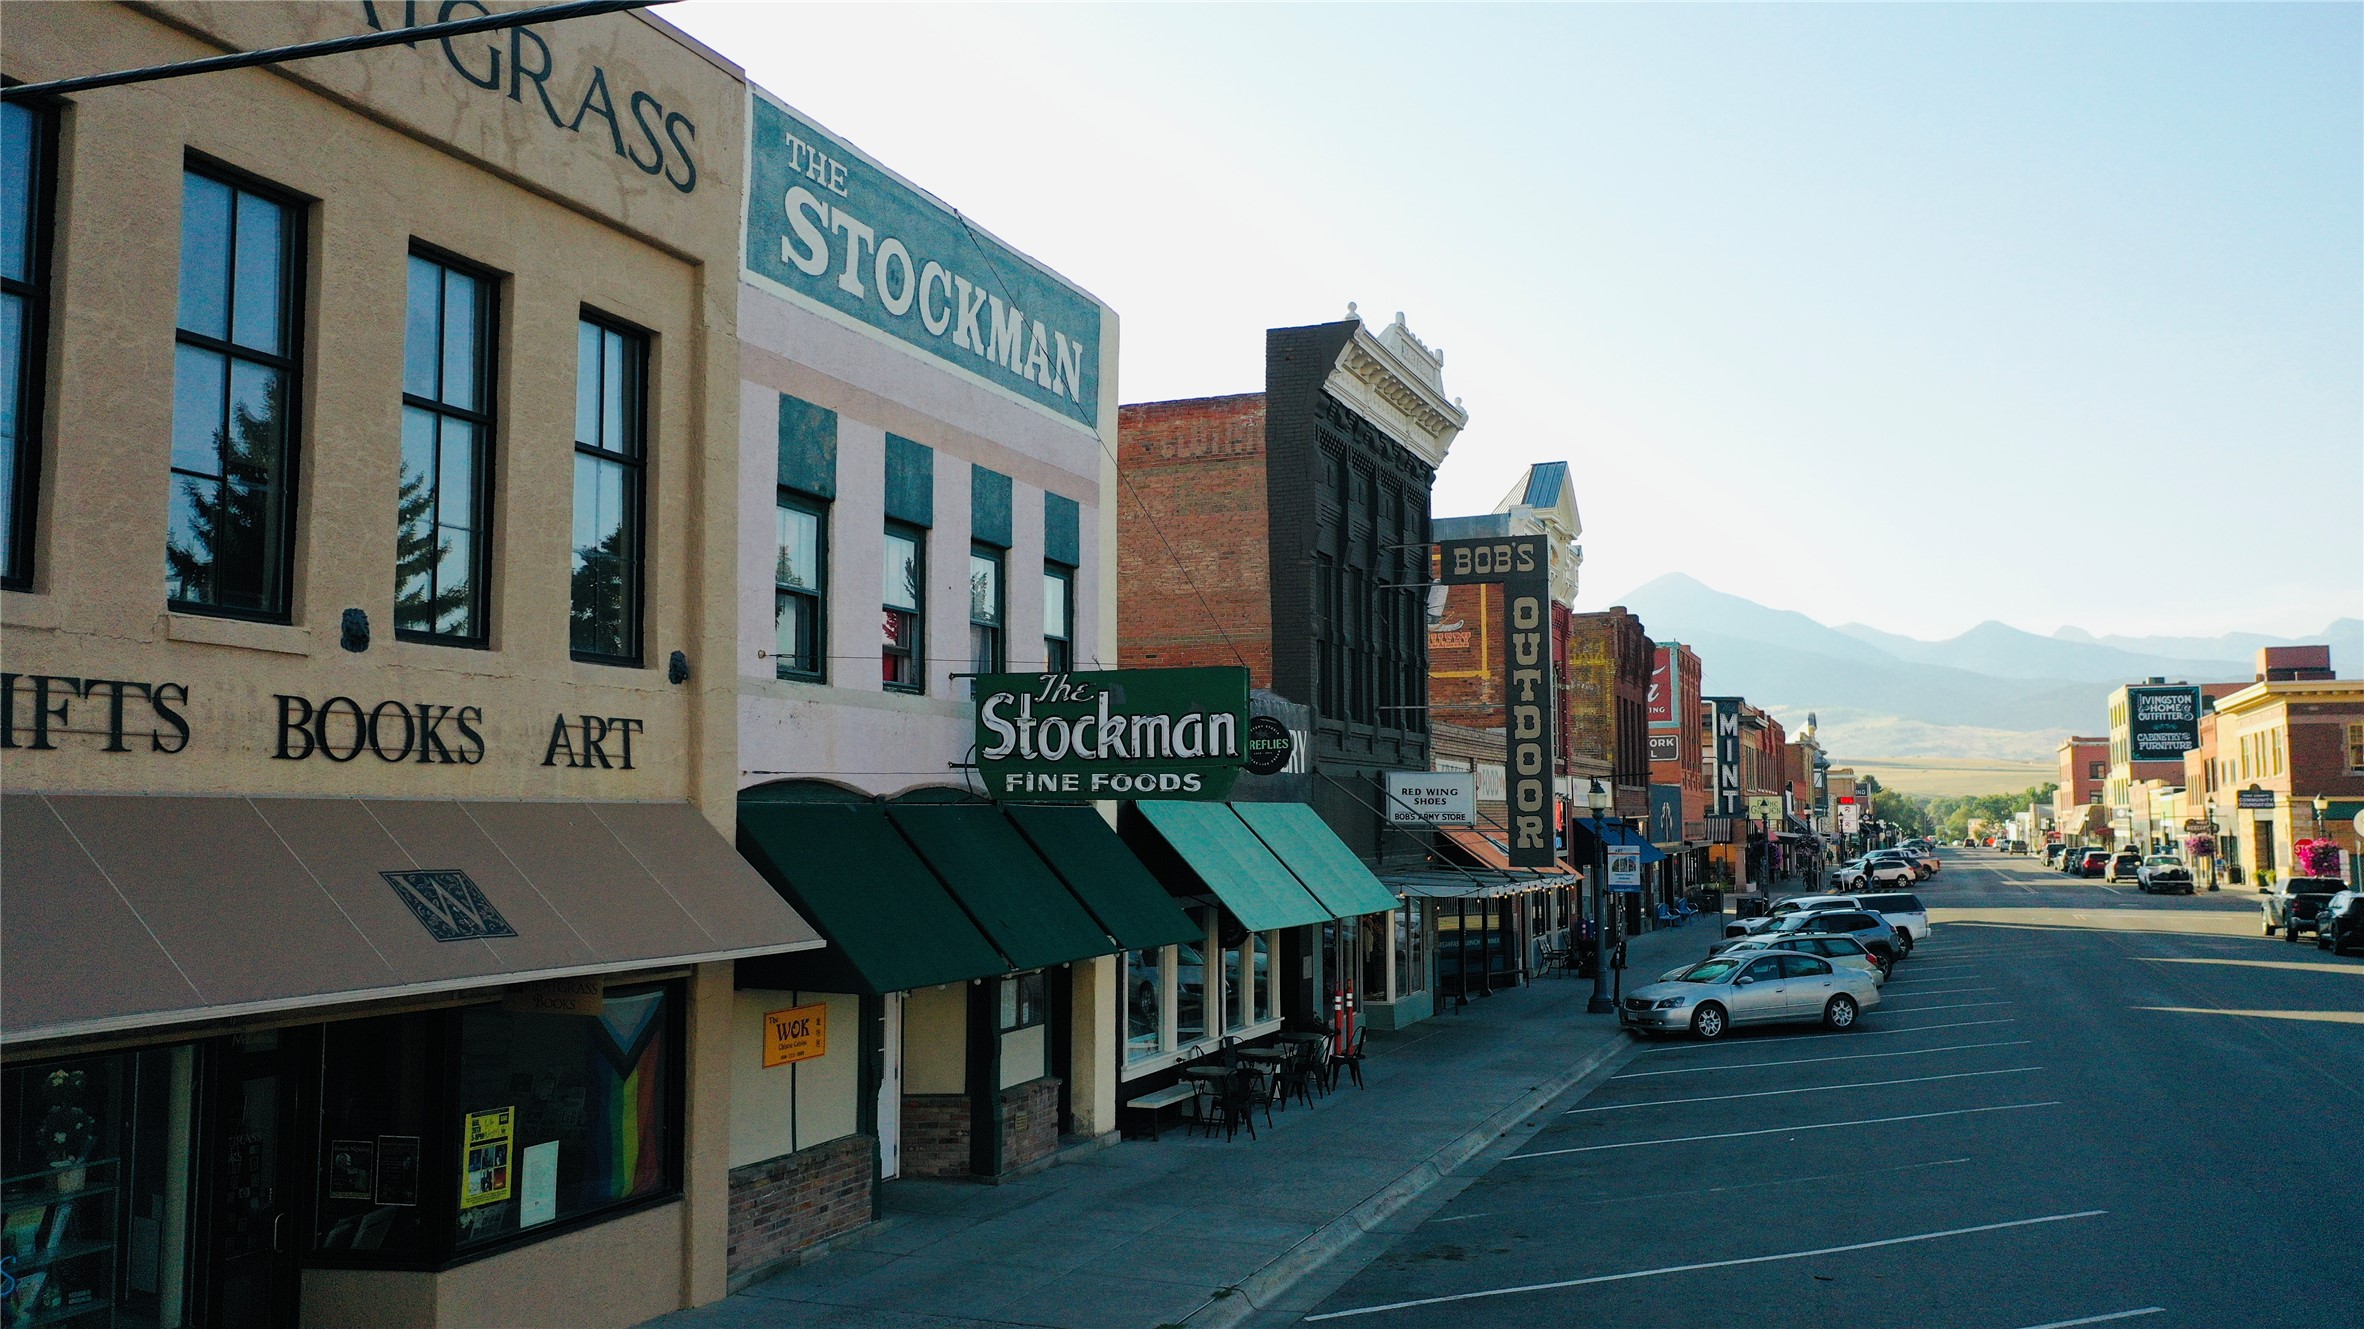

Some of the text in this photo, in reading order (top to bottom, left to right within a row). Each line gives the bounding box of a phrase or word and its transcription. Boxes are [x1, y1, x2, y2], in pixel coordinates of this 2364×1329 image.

[786, 133, 848, 198] THE
[781, 186, 1082, 404] STOCKMAN
[1454, 542, 1535, 575] BOB'S
[1428, 632, 1472, 648] LLERY
[1034, 673, 1096, 703] The
[271, 694, 485, 765] BOOKS
[540, 713, 643, 769] ART
[981, 691, 1240, 761] Stockman
[1512, 597, 1545, 849] OUTDOOR
[1249, 738, 1289, 750] REFLIES
[2137, 732, 2181, 742] CABINETRY
[2139, 741, 2193, 750] FURNITURE
[1280, 729, 1307, 774] RY
[1720, 713, 1739, 814] MINT
[1006, 772, 1202, 792] FINE FOODS
[1402, 788, 1458, 796] RED WING
[1414, 797, 1447, 805] SHOES
[1395, 812, 1415, 820] BOB'S
[1442, 813, 1466, 821] STORE
[777, 1018, 809, 1041] WOK
